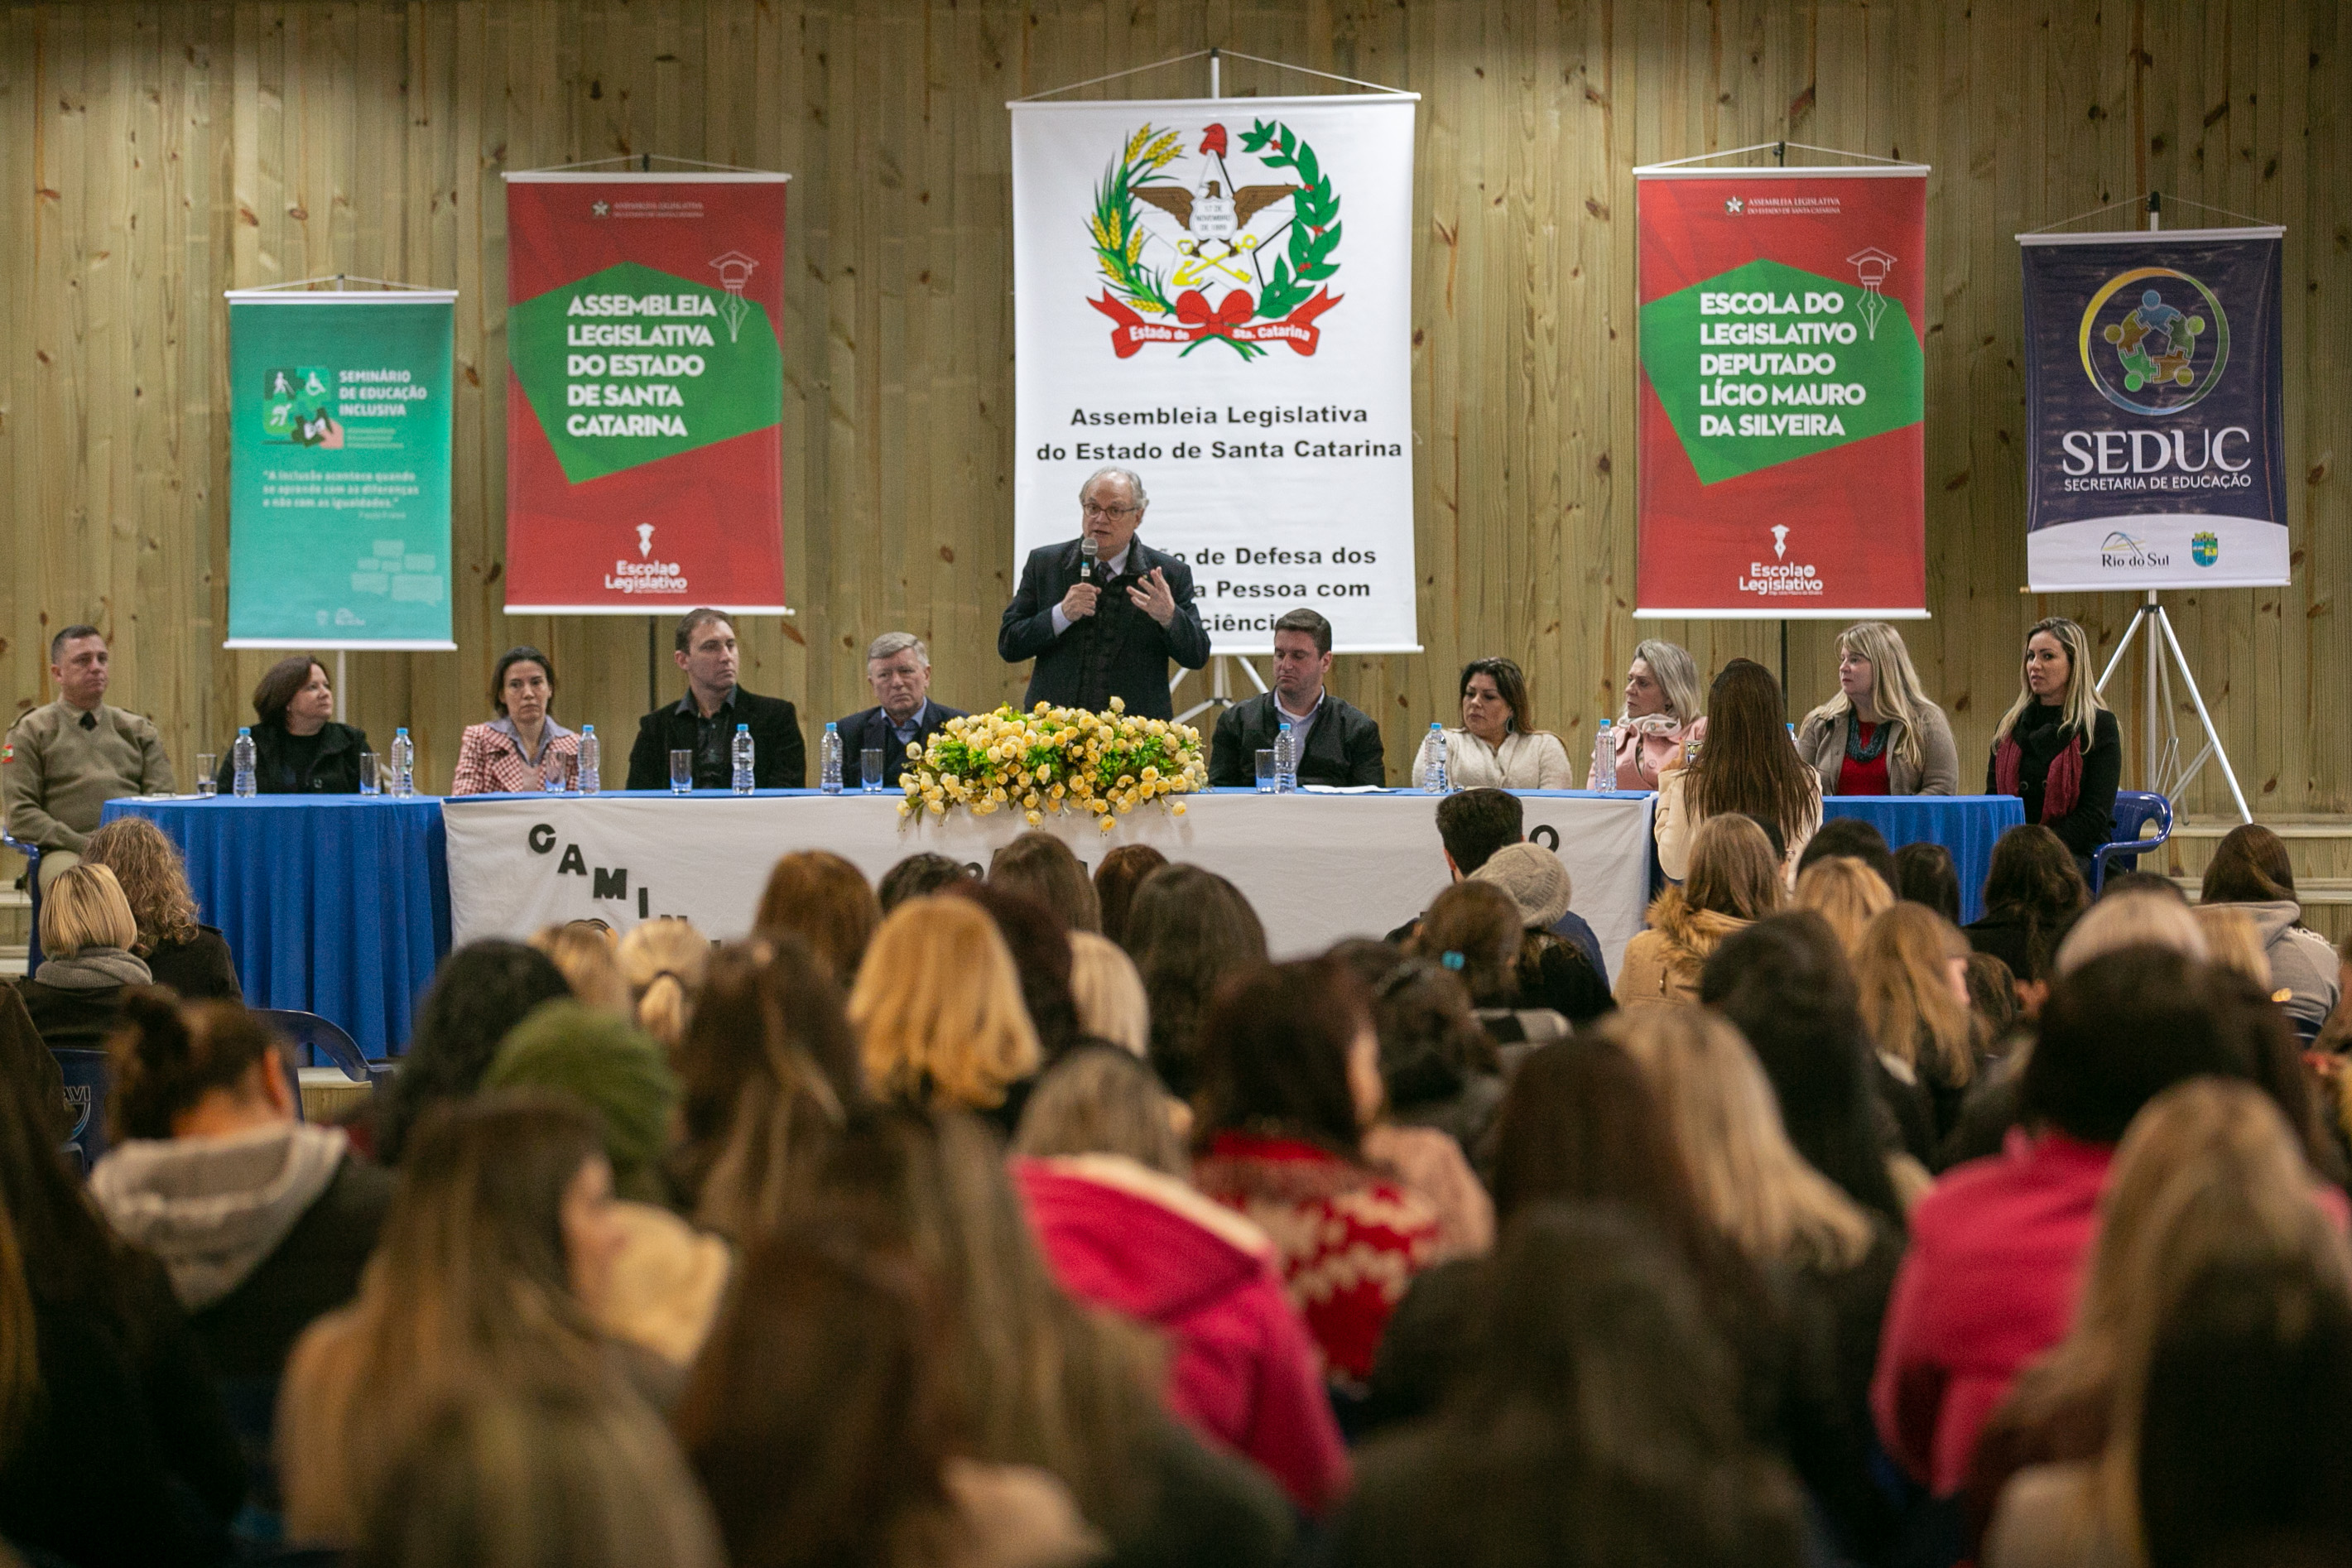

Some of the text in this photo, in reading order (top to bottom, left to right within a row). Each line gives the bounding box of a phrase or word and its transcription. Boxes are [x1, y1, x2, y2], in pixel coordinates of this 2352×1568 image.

[567, 295, 718, 317] ASSEMBLEIA
[1700, 292, 1845, 315] ESCOLA DO
[567, 324, 715, 347] LEGISLATIVA
[1129, 325, 1311, 342] Estado de Sta. Catarina
[1700, 322, 1857, 345] LEGISLATIVO
[339, 367, 411, 383] SEMINÁRIO
[567, 354, 705, 377] DO ESTADO
[1700, 353, 1836, 376] DEPUTADO
[339, 385, 428, 402] DE EDUCAÇÃO
[567, 383, 685, 407] DE SANTA
[1700, 378, 1866, 406] LÍCIO MAURO
[339, 403, 407, 416] INCLUSIVA
[1071, 406, 1368, 428] Assembleia Legislativa
[566, 414, 689, 437] CATARINA
[1700, 414, 1846, 436] DA SILVEIRA
[1037, 440, 1402, 460] do Estado de Santa Catarina
[2062, 426, 2251, 476] SEDUC
[2065, 473, 2251, 492] SECRETARIA DE EDUCAÇÃO
[1196, 547, 1225, 565] de
[1236, 547, 1322, 565] Defesa
[1332, 547, 1376, 564] dos
[2102, 553, 2169, 567] Rio do Sul
[616, 559, 669, 576] Escola
[1751, 561, 1803, 577] Escola
[604, 573, 688, 594] Legislativo
[1194, 580, 1370, 598] a Pessoa com
[1739, 575, 1823, 595] Legislativo
[1201, 613, 1274, 631] ciênci
[528, 824, 687, 921] CAMI
